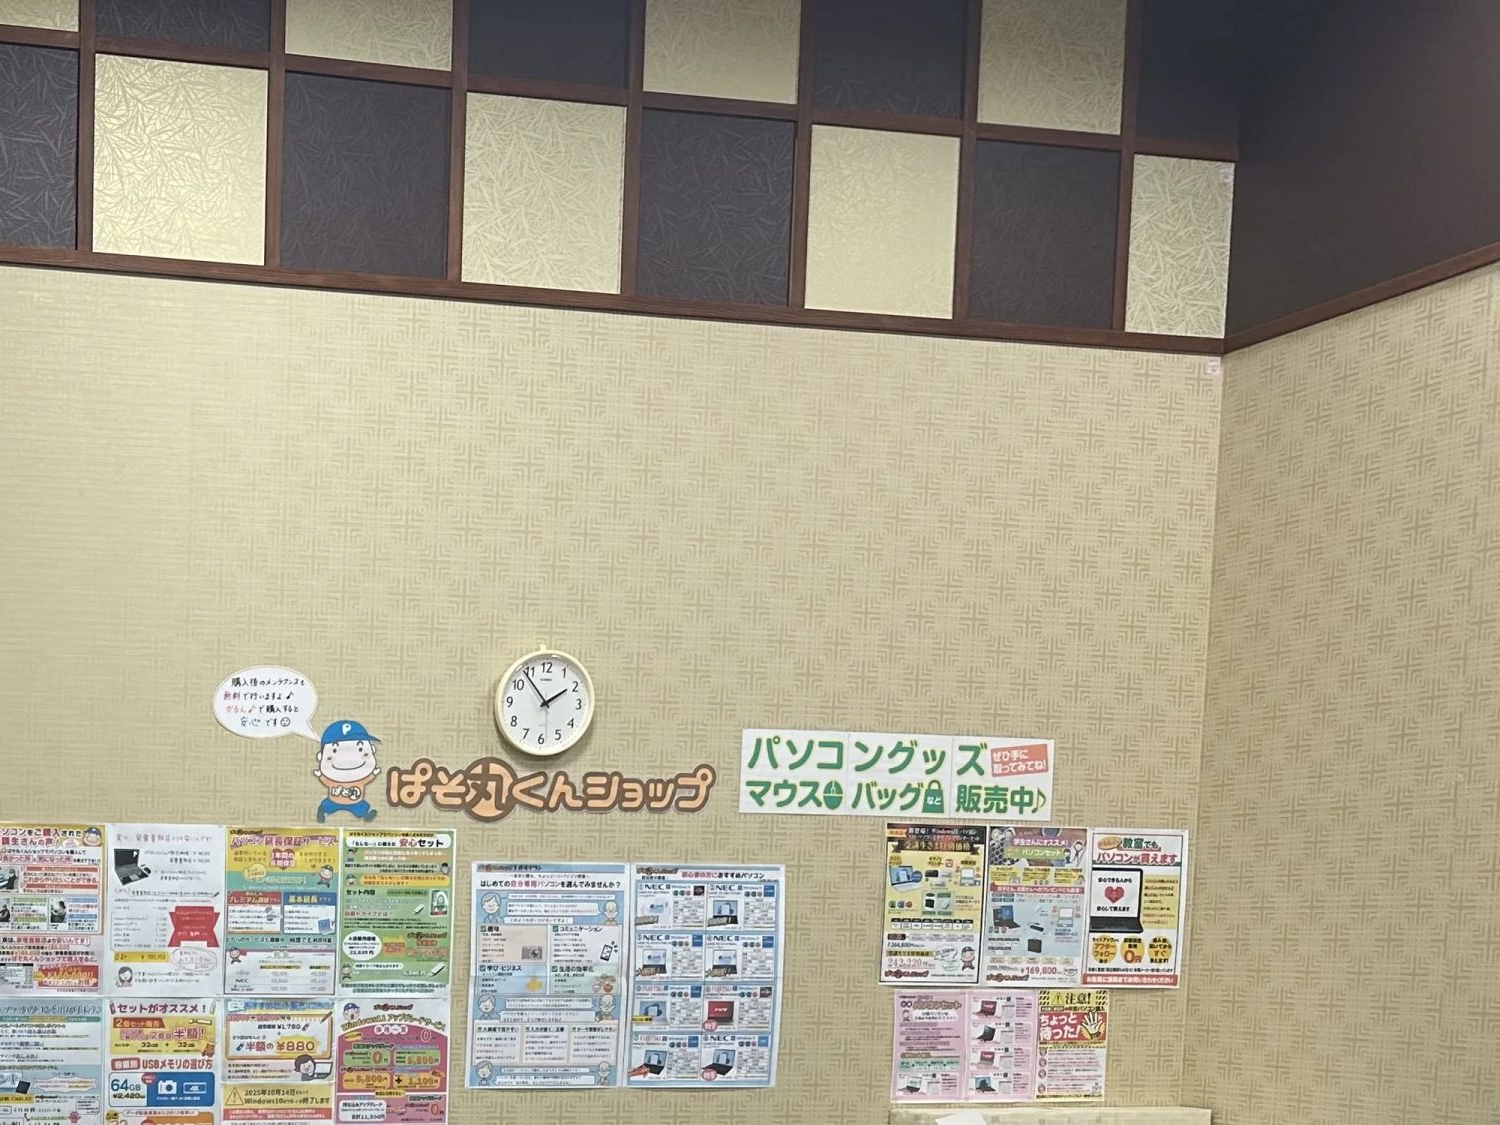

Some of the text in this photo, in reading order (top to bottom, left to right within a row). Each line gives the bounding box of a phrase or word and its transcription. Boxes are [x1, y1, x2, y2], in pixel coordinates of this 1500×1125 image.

[526, 666, 535, 677] 11
[542, 662, 552, 673] 12
[562, 668, 566, 678] 1
[513, 679, 524, 690] 10
[572, 681, 579, 692] 2
[506, 697, 513, 707] 9
[576, 699, 582, 710] 3
[510, 716, 517, 727] 8
[567, 718, 574, 728] 4
[523, 728, 529, 739] 7
[538, 734, 544, 744] 6
[555, 729, 561, 740] 5
[748, 736, 988, 776] パソコングッズ
[388, 757, 714, 821] ぱそ丸くんショップ
[746, 780, 823, 808] マウス
[851, 780, 925, 810] バッグ
[926, 796, 942, 806] など
[399, 838, 444, 848] 安心セット
[1098, 852, 1178, 864] パソコンが買えます
[480, 880, 620, 888] はじめての自分専用パソコンを選んでみませんか?
[1124, 950, 1142, 964] 0円
[1021, 967, 1057, 975] ¥169,800
[1066, 992, 1091, 1005] 注意!
[117, 1003, 206, 1014] セットがオススメ!
[1040, 1013, 1077, 1026] ちょっと
[1040, 1025, 1080, 1040] 待った!
[246, 1041, 315, 1052] 半額の ¥880
[142, 1059, 213, 1070] USBメモリの選び方
[110, 1079, 141, 1092] 64GB
